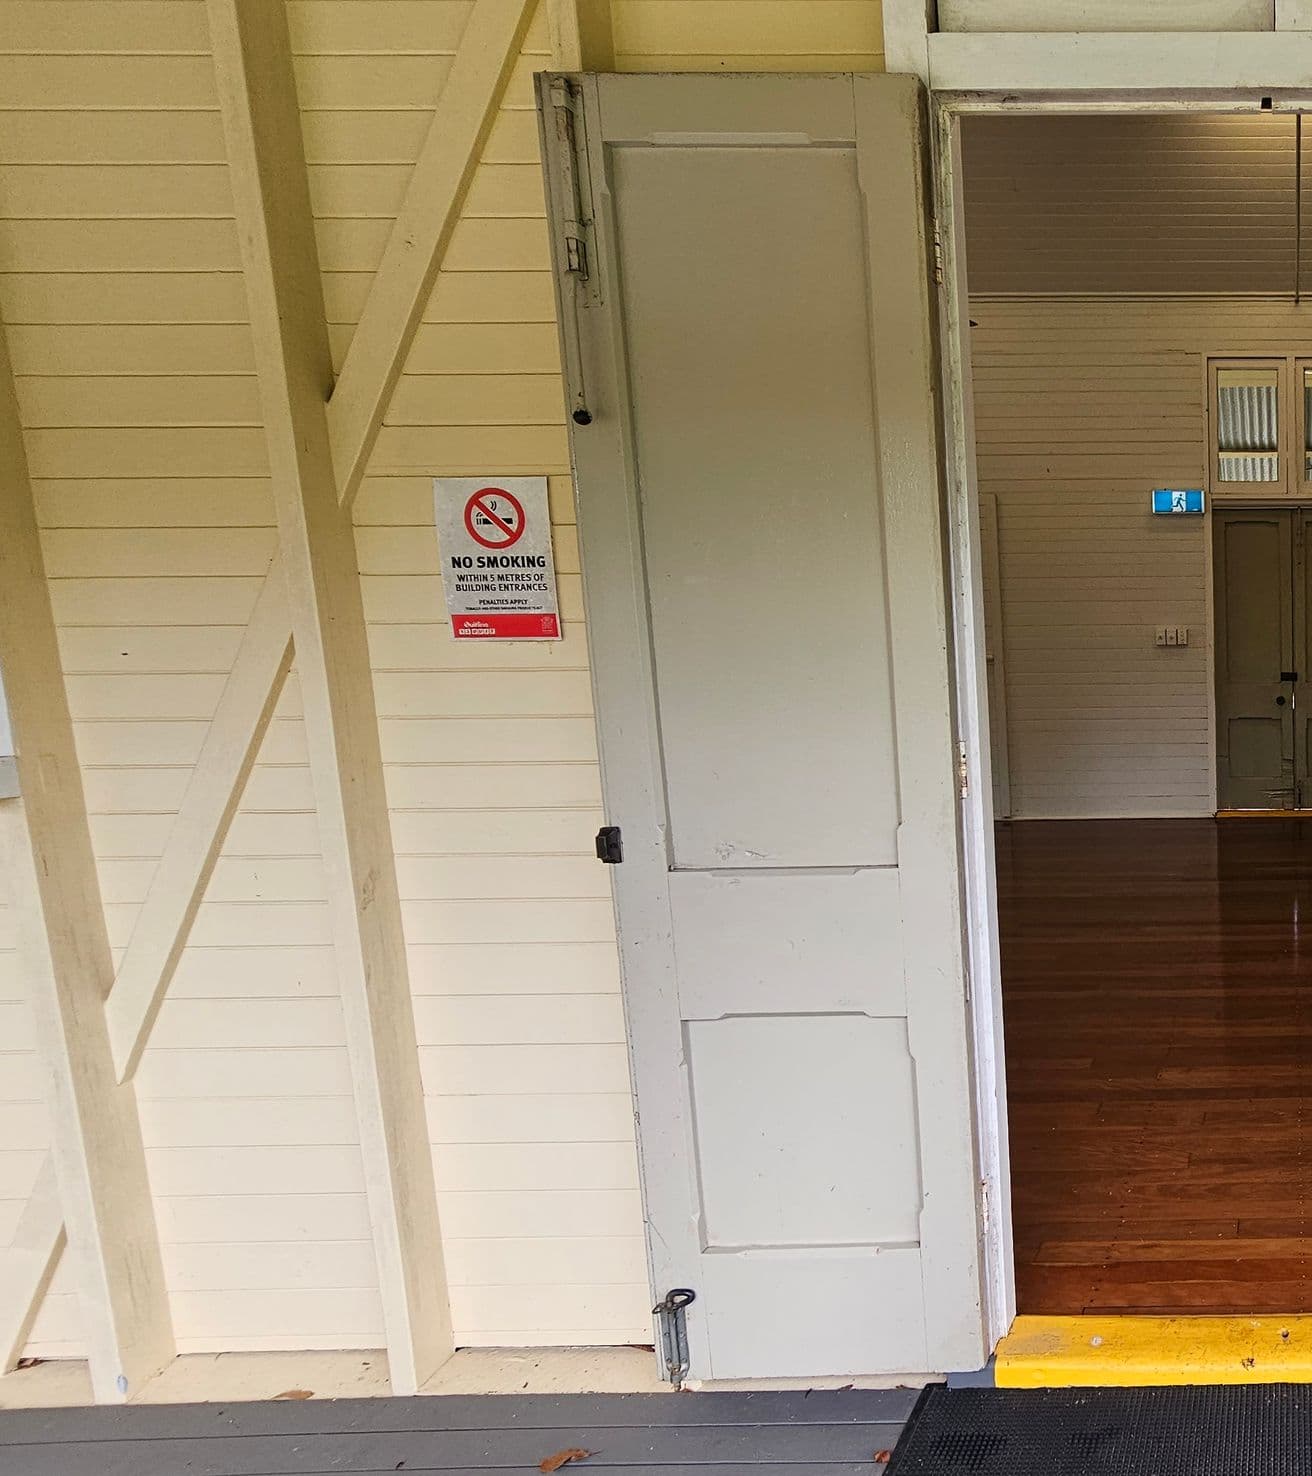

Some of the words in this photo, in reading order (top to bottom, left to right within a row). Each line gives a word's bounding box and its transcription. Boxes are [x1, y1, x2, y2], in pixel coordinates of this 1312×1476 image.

[451, 556, 473, 568] NO
[477, 556, 546, 568] SMOKING
[457, 574, 488, 582] WITHIN
[490, 574, 494, 582] 5
[498, 574, 532, 582] METRES
[534, 574, 544, 582] OF
